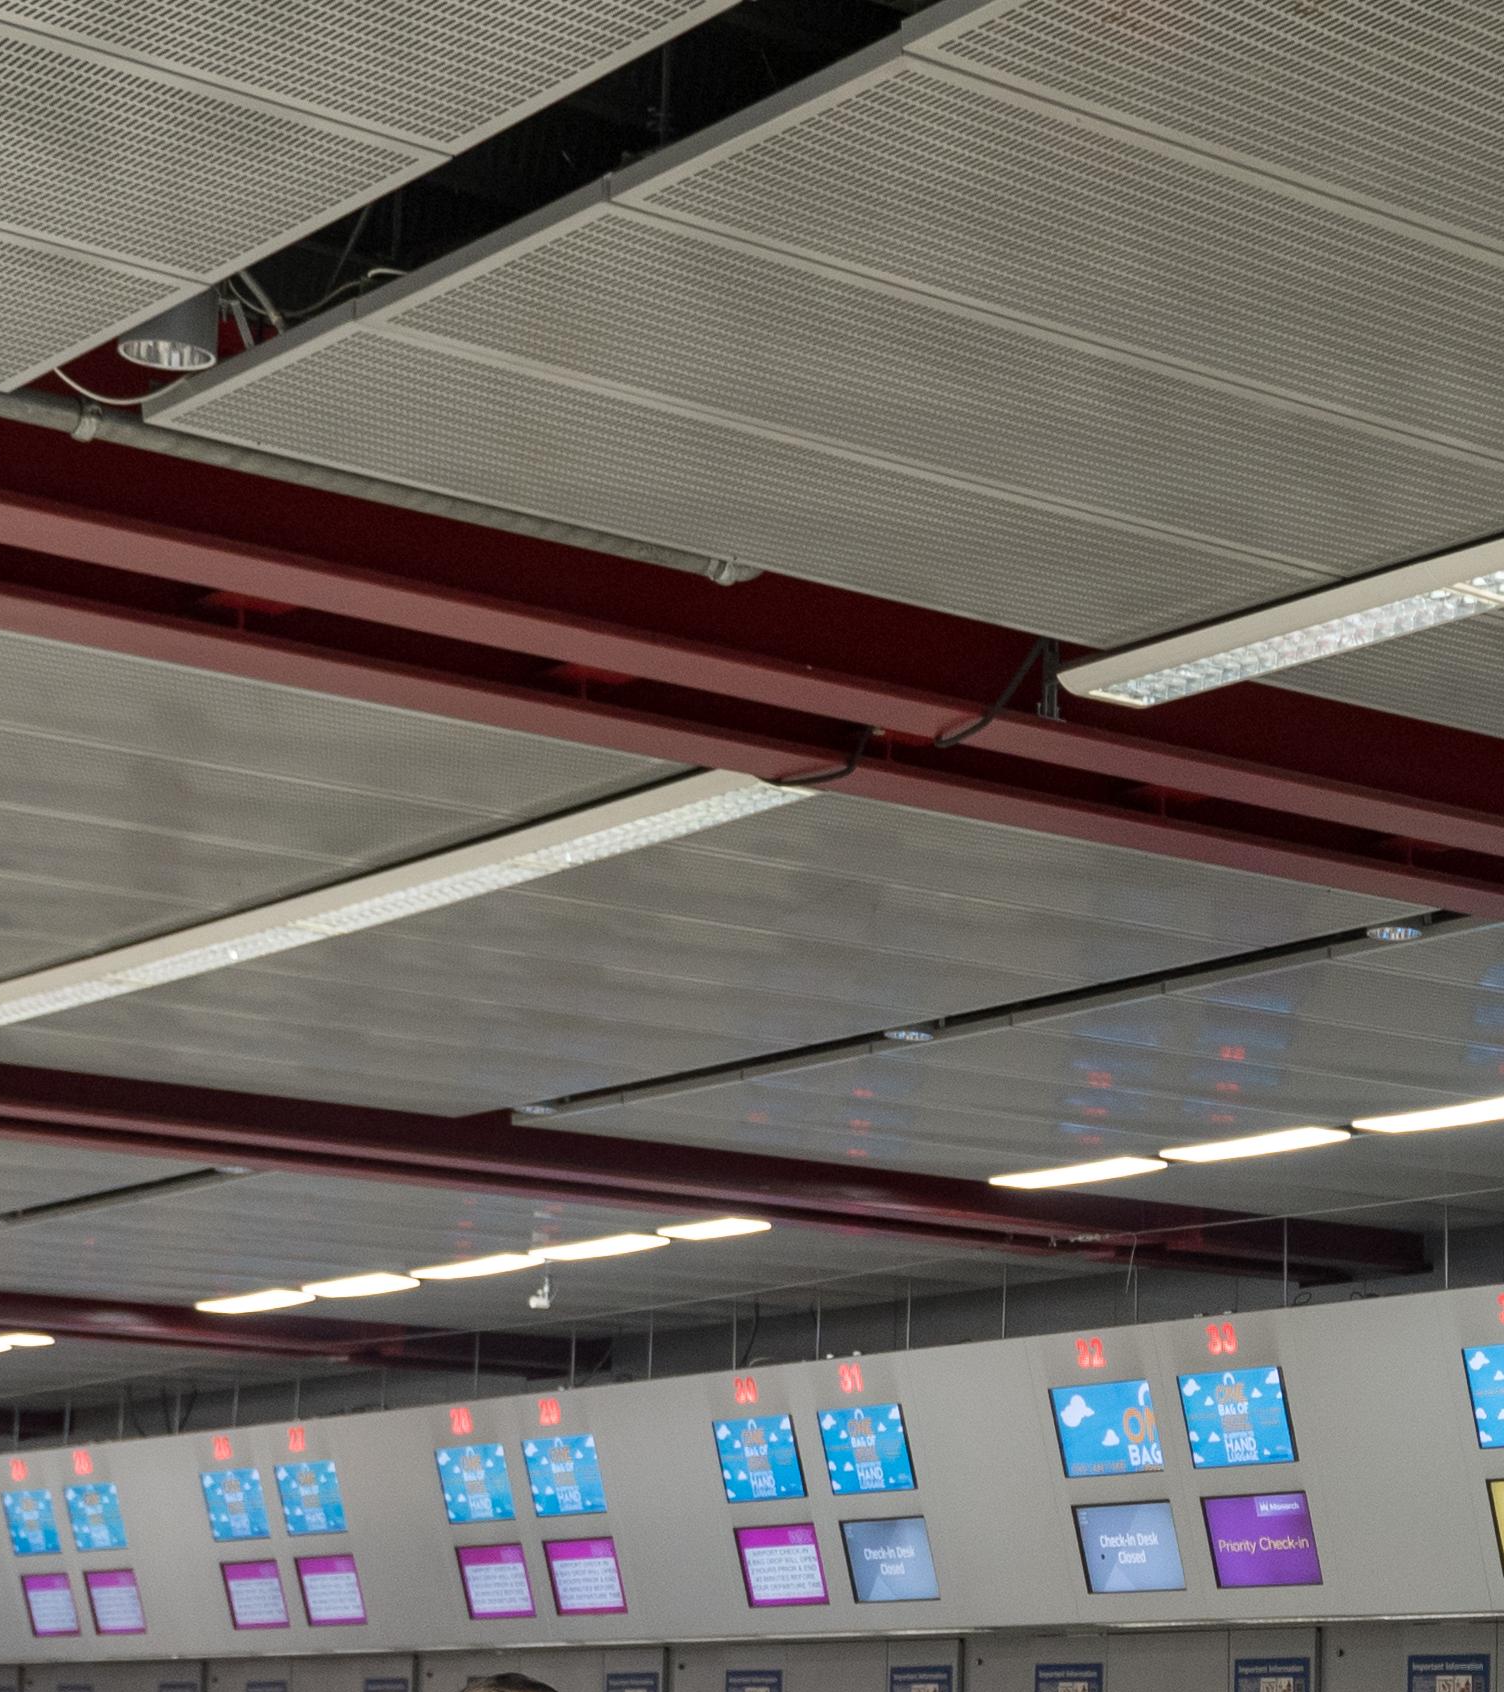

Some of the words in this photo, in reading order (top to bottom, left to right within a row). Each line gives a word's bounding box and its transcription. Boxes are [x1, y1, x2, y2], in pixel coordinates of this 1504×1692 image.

[1225, 1438, 1256, 1451] HAND
[1128, 1442, 1163, 1466] BAG
[1137, 1531, 1159, 1547] Desk
[1218, 1539, 1256, 1554] Priority
[1260, 1535, 1310, 1551] Check-in
[1118, 1550, 1146, 1564] Closed
